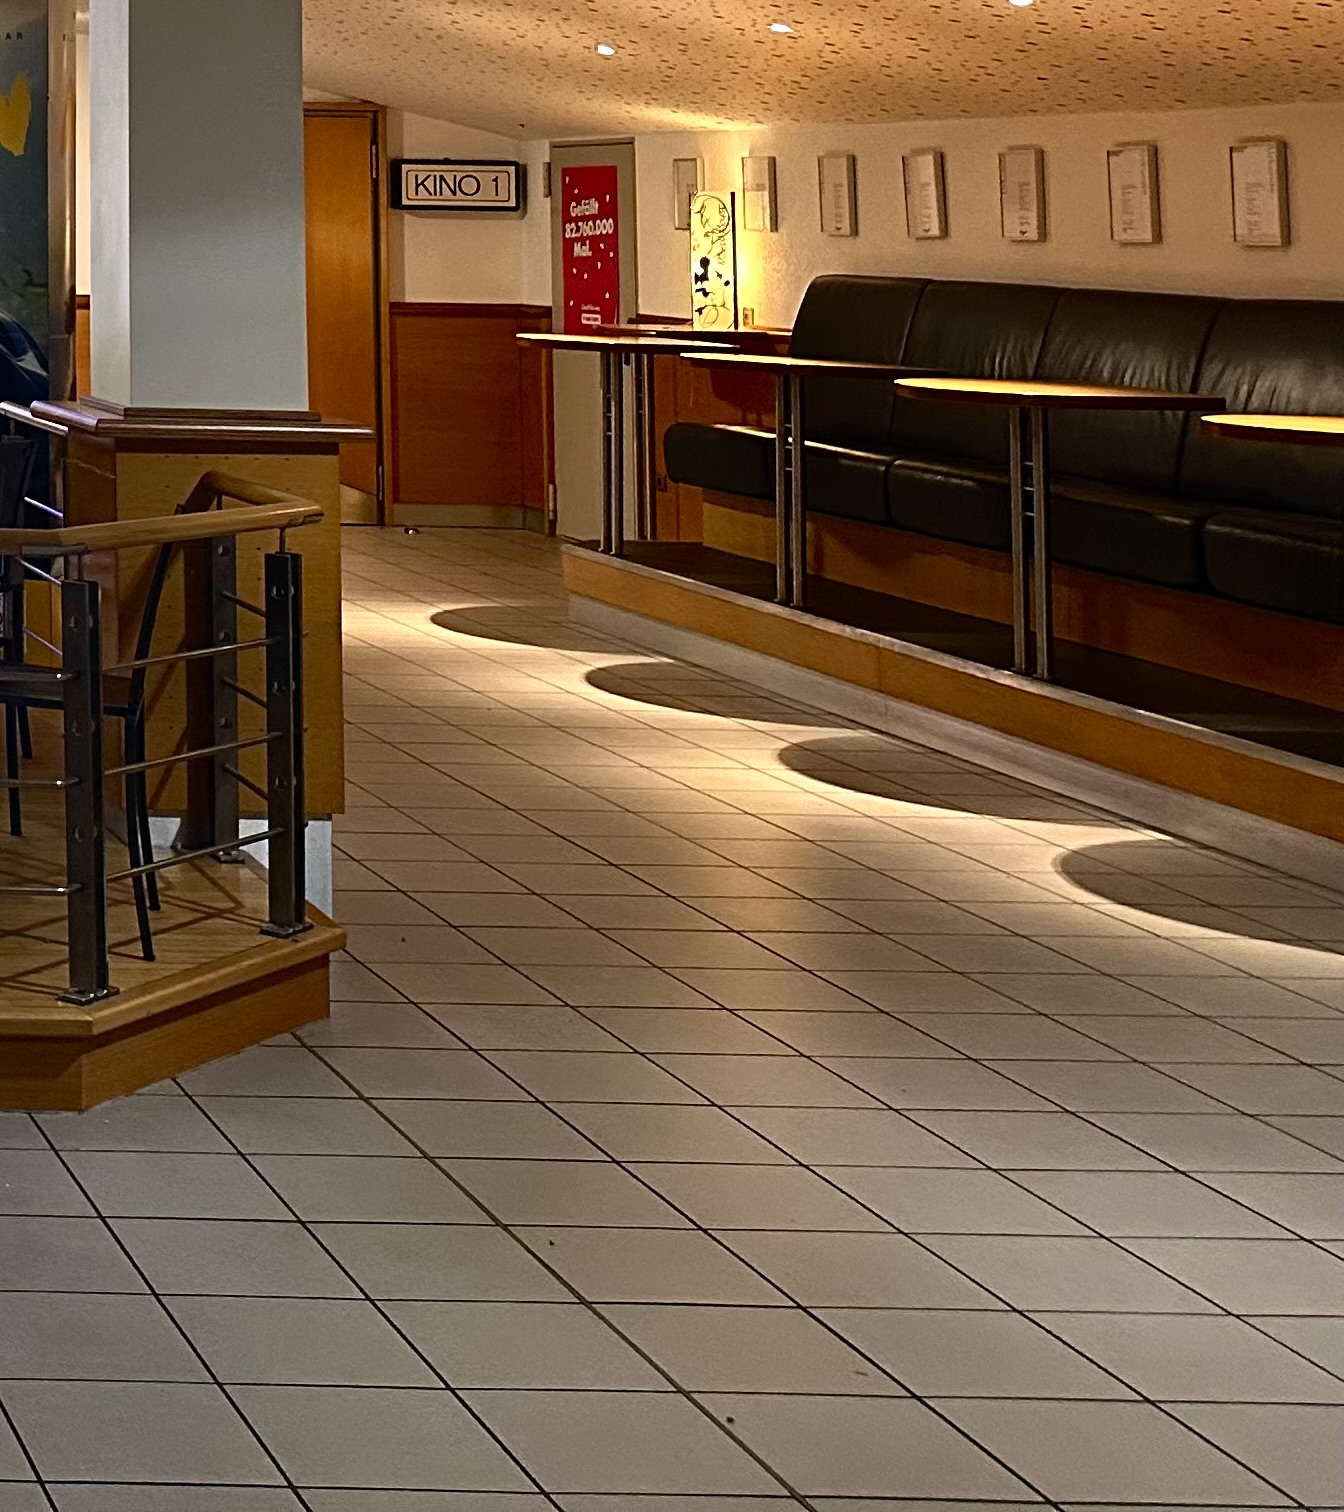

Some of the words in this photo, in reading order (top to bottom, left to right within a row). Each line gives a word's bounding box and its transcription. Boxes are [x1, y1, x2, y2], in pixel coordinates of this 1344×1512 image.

[414, 174, 481, 197] KINO
[491, 175, 499, 197] 1
[570, 197, 599, 217] Gefällt
